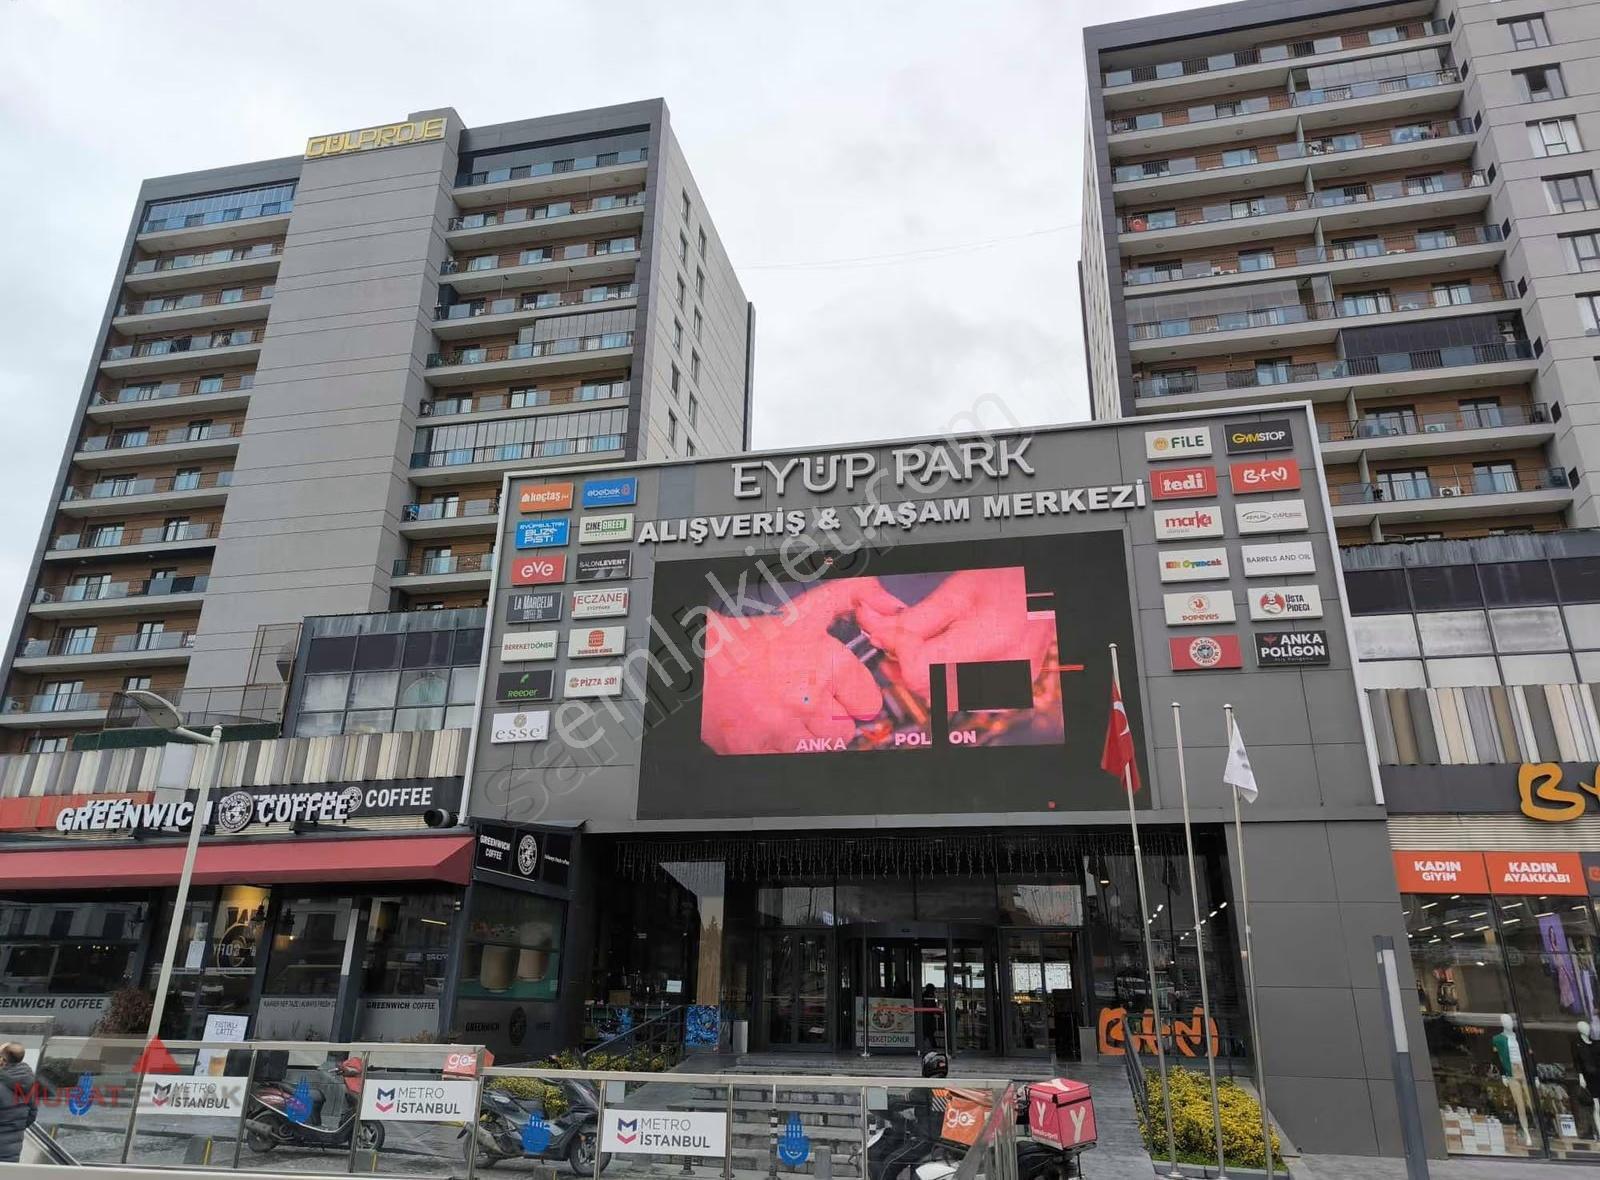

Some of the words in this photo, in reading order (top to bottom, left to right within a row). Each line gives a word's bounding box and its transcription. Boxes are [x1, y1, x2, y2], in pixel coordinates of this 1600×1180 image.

[305, 117, 447, 157] GÜLPROJE
[731, 452, 877, 499] EYÜP
[892, 436, 1036, 485] PARK
[1163, 472, 1204, 492] tedi
[587, 487, 620, 497] ebebek
[637, 506, 807, 545] ALIŞVERİŞ
[818, 507, 841, 531] &
[853, 498, 971, 531] YAŞAM
[983, 479, 1147, 520] MERKEZİ
[521, 561, 554, 577] eve
[577, 592, 623, 604] ECZANE
[1280, 633, 1324, 645] ANKA
[1261, 644, 1326, 658] POLİGON
[495, 727, 542, 741] esse
[796, 737, 847, 752] ANKA
[366, 786, 434, 808] COFFEE
[258, 794, 352, 823] COFFEE
[480, 834, 511, 851] GREENWICH
[485, 848, 503, 860] COFFEE
[1414, 861, 1461, 872] KADIN
[1508, 861, 1558, 873] KADIN
[1504, 873, 1571, 883] AYAKKABI
[60, 998, 103, 1009] COFFEE
[366, 1002, 410, 1010] GREENWICH
[412, 1002, 436, 1010] COFFEE
[173, 1082, 217, 1096] METRO
[398, 1087, 445, 1099] METRO
[170, 1096, 231, 1109] İSTANBUL
[396, 1100, 462, 1114] İSTANBUL
[640, 1118, 692, 1132] METRO
[639, 1132, 711, 1148] İSTANBUL
